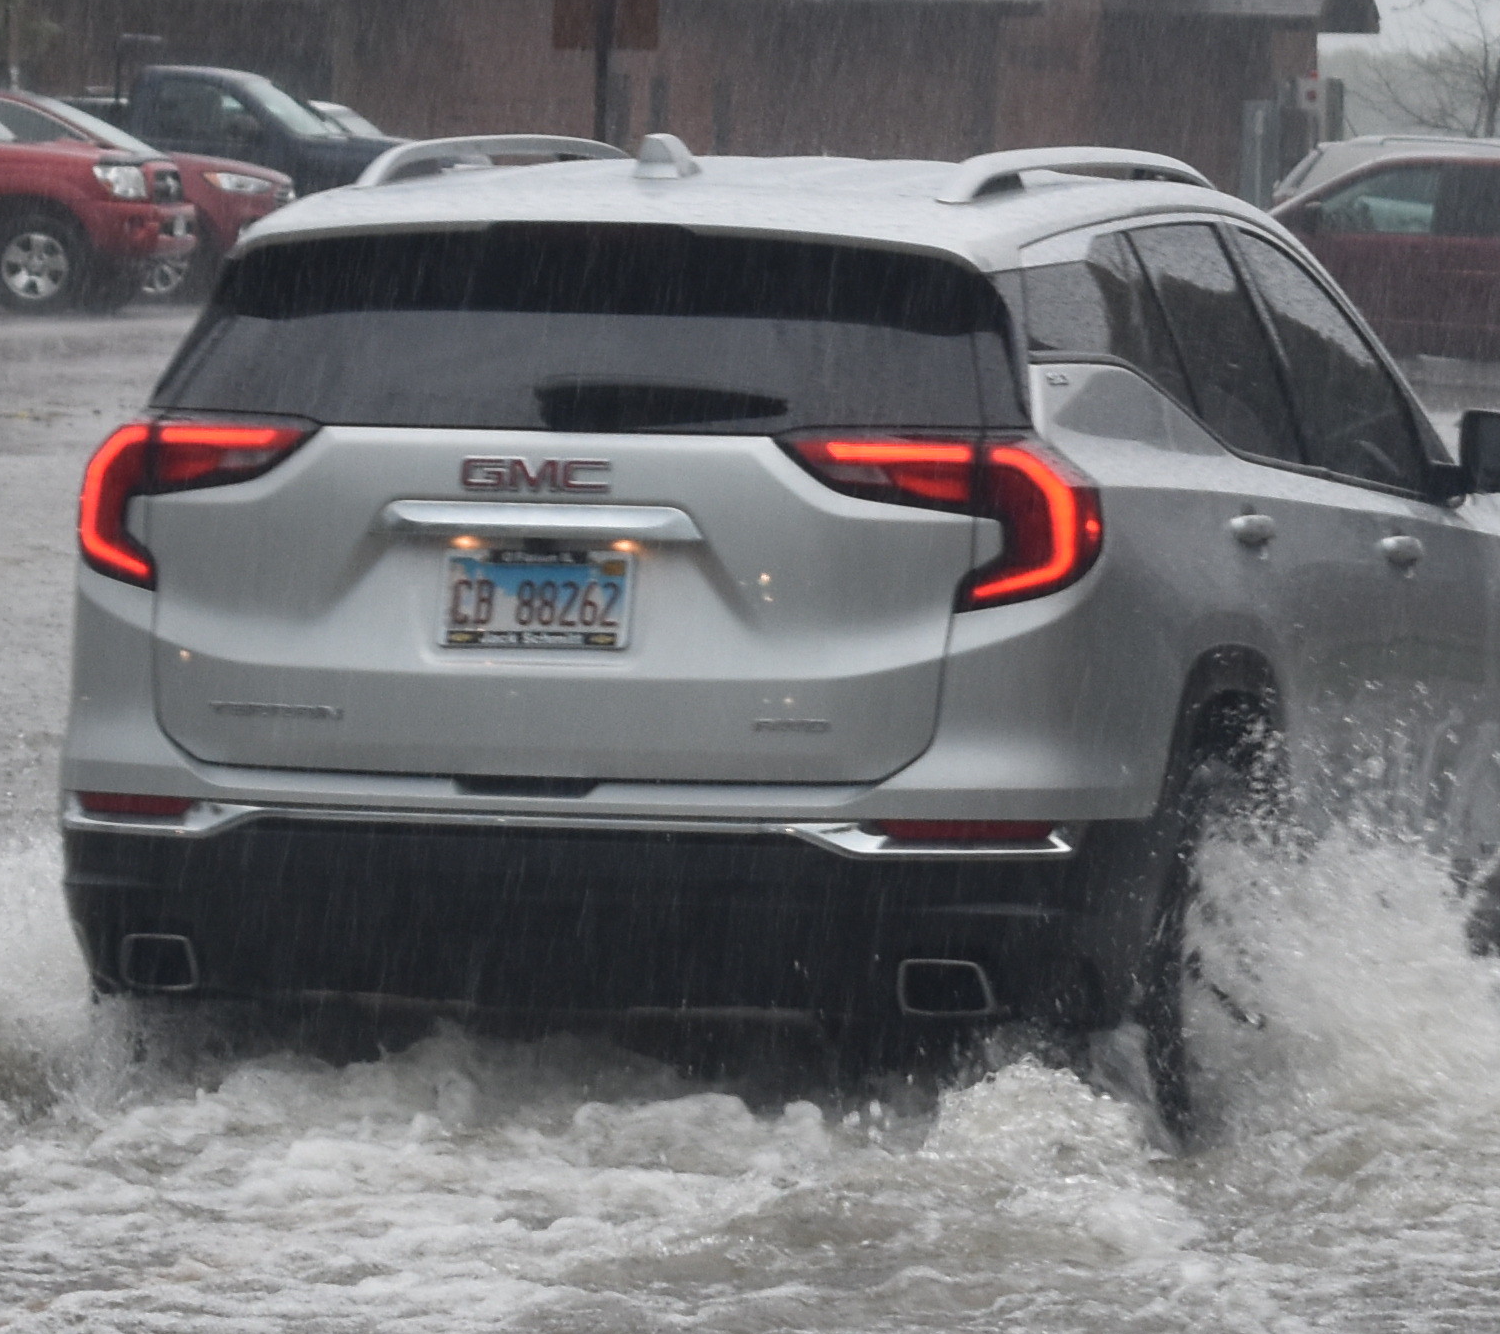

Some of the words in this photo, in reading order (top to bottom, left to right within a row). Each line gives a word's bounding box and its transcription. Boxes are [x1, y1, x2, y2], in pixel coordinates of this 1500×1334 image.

[462, 455, 611, 493] GMC
[451, 578, 495, 625] CB
[515, 579, 621, 627] 88262
